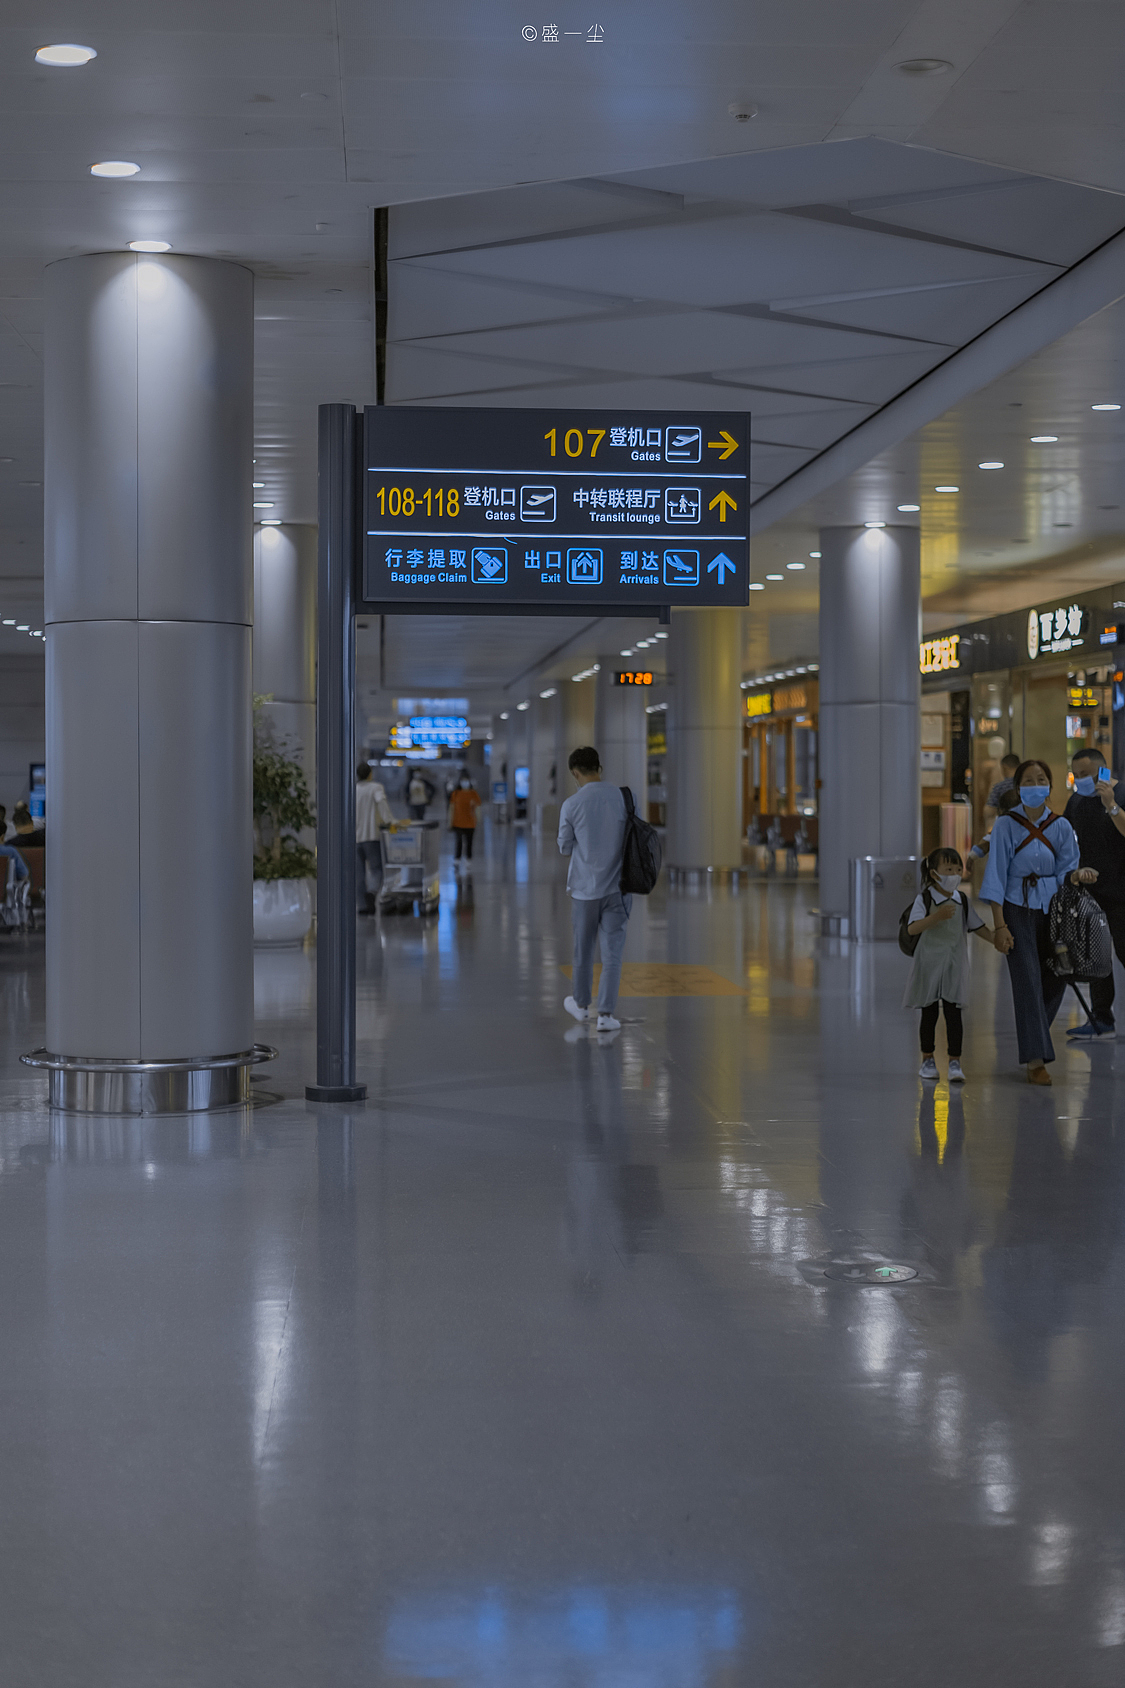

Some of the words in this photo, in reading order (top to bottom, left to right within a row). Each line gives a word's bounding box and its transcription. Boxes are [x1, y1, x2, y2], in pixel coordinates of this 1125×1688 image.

[544, 429, 606, 458] 107
[609, 426, 663, 448] 登机口
[631, 450, 662, 462] Gates
[376, 487, 460, 518] 108-118
[463, 486, 516, 507] 登机口
[573, 487, 661, 509] 中转联程厅
[485, 510, 516, 521] Gates
[589, 511, 625, 523] Transit
[627, 512, 661, 525] lounge
[385, 548, 467, 569] 行李提取
[525, 549, 562, 570] 出口
[620, 550, 660, 571] 到达
[391, 572, 437, 585] Baggage
[438, 572, 468, 583] Claim
[541, 573, 562, 584] Exit
[619, 574, 660, 585] Arrivals
